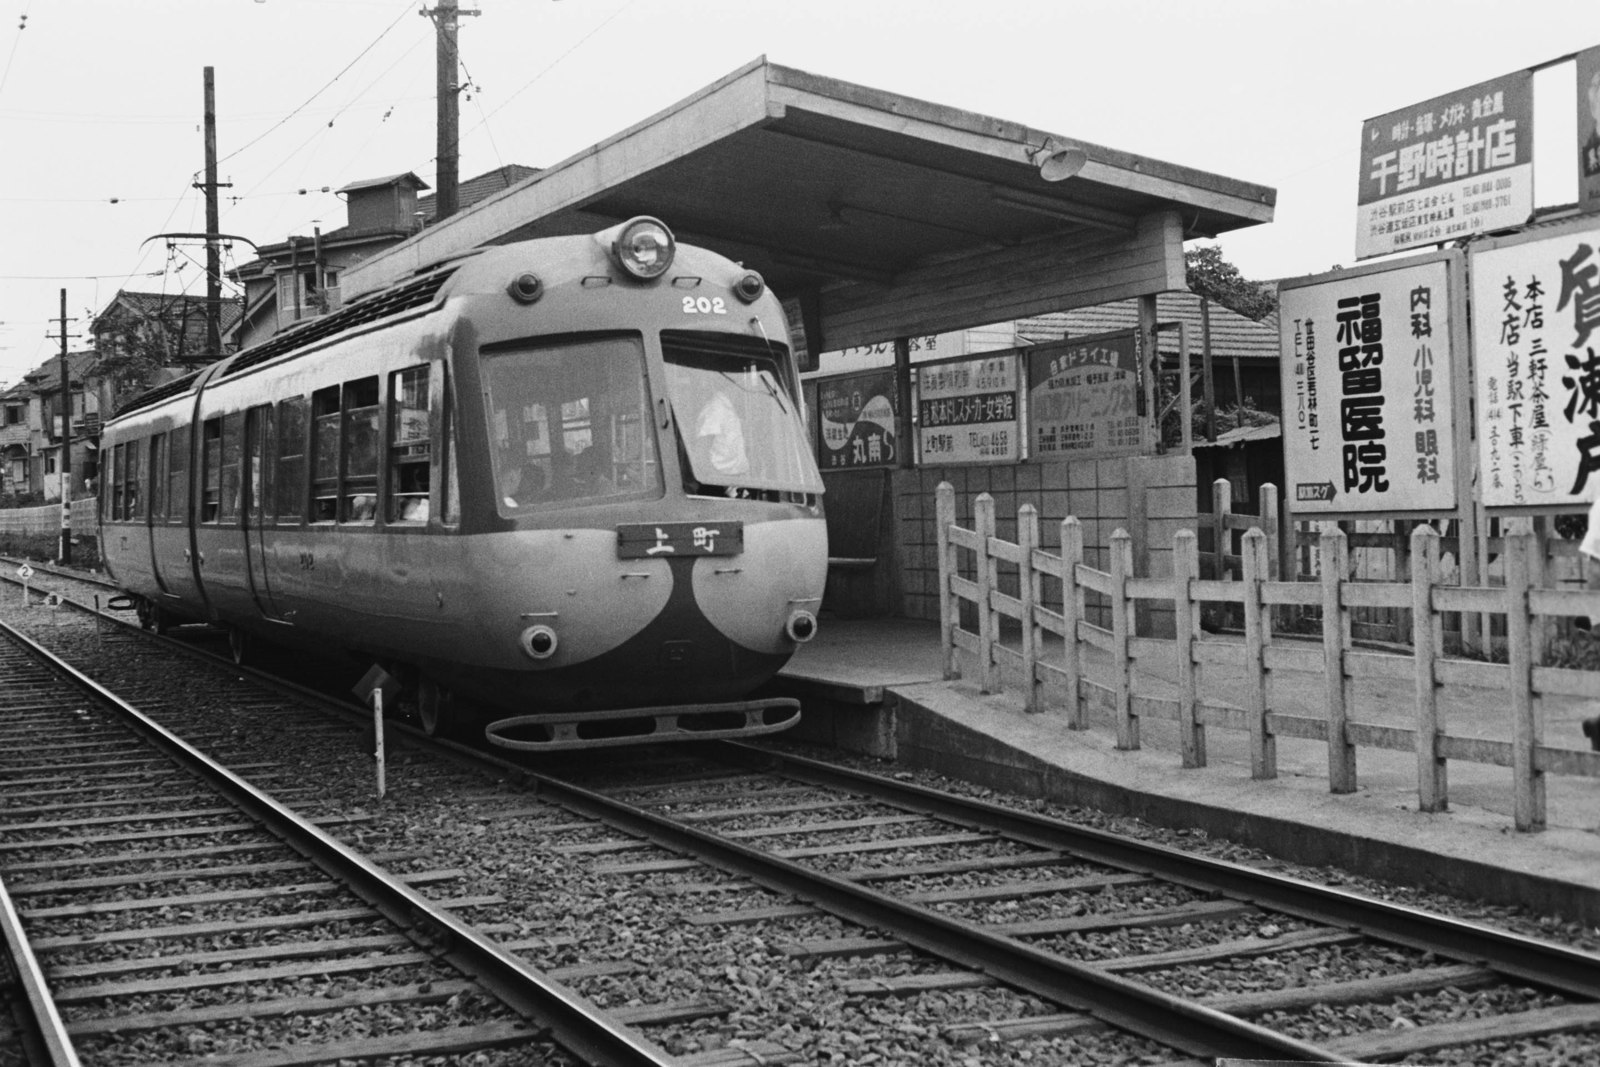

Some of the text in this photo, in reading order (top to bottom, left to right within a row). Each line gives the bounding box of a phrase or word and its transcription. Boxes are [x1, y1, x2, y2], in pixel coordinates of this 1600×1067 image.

[682, 296, 727, 314] 202
[1500, 275, 1522, 345] 支店
[1523, 274, 1546, 329] 本店
[1336, 292, 1389, 494] 福留医院
[1410, 284, 1441, 485] 内科 小児科 眼科
[646, 527, 720, 555] 上町
[22, 566, 29, 577] 2
